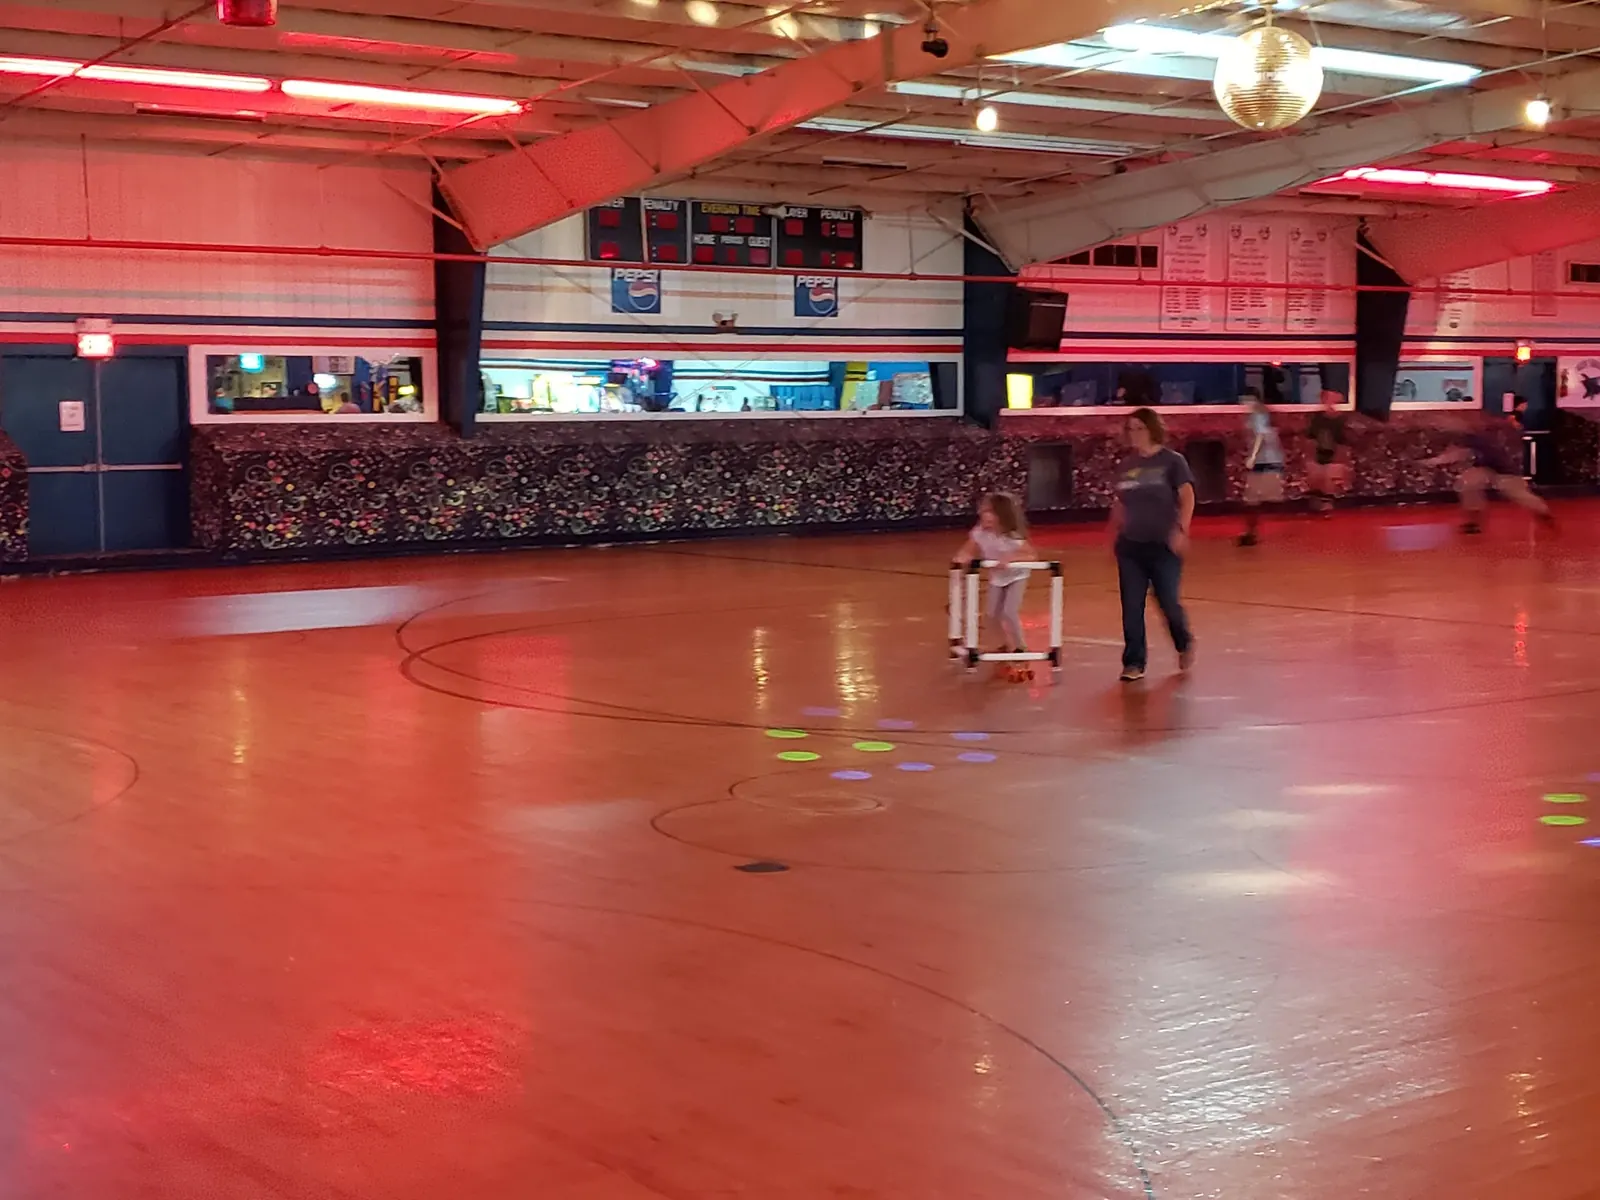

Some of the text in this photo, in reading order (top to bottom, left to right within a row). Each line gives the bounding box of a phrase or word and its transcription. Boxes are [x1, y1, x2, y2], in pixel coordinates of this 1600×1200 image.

[784, 207, 808, 218] LAYER
[820, 209, 855, 220] PENALTY
[694, 234, 716, 244] HOME
[747, 236, 772, 247] GUEST
[613, 268, 658, 282] PEPSI
[796, 275, 836, 288] PEPSI
